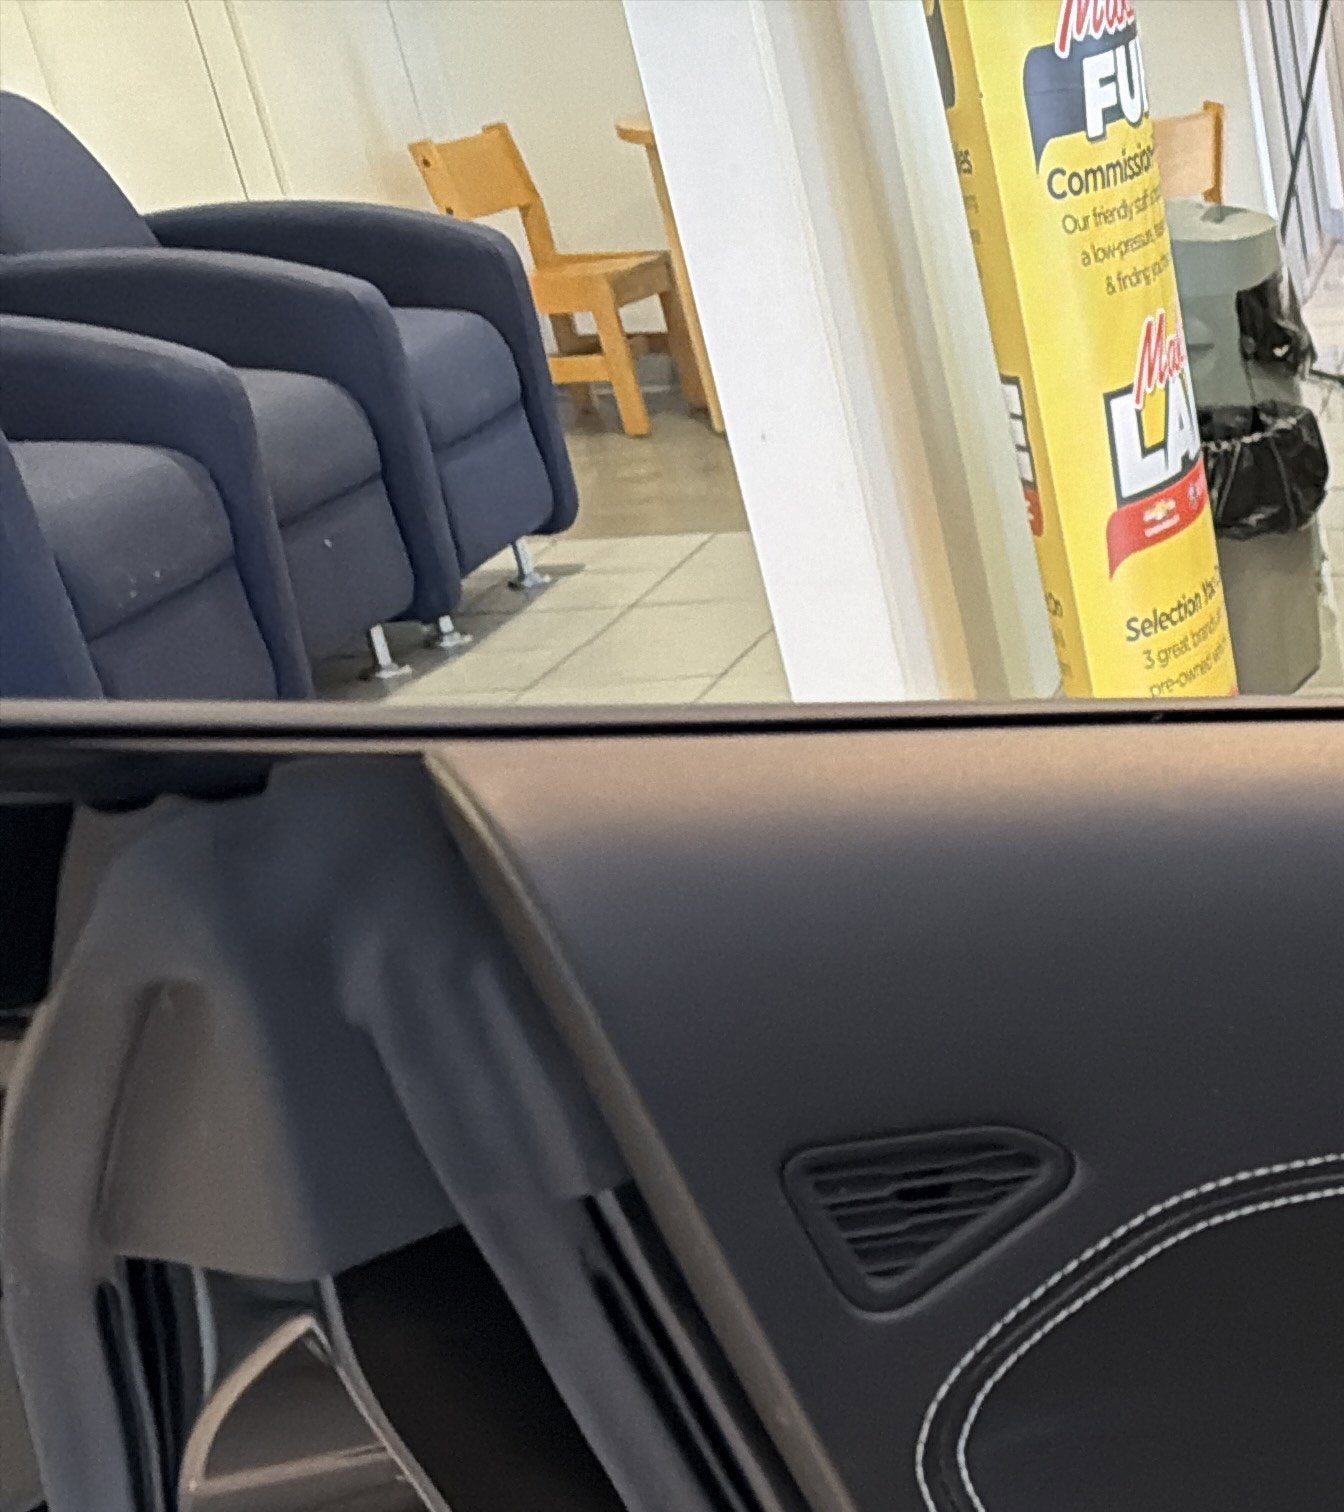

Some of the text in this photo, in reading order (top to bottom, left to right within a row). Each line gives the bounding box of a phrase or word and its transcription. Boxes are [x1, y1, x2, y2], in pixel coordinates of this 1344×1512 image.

[1062, 214, 1090, 234] Our
[1081, 250, 1091, 267] a
[1105, 275, 1116, 295] &
[1126, 591, 1202, 642] Selection
[1142, 648, 1155, 670] 3
[1157, 634, 1191, 668] great
